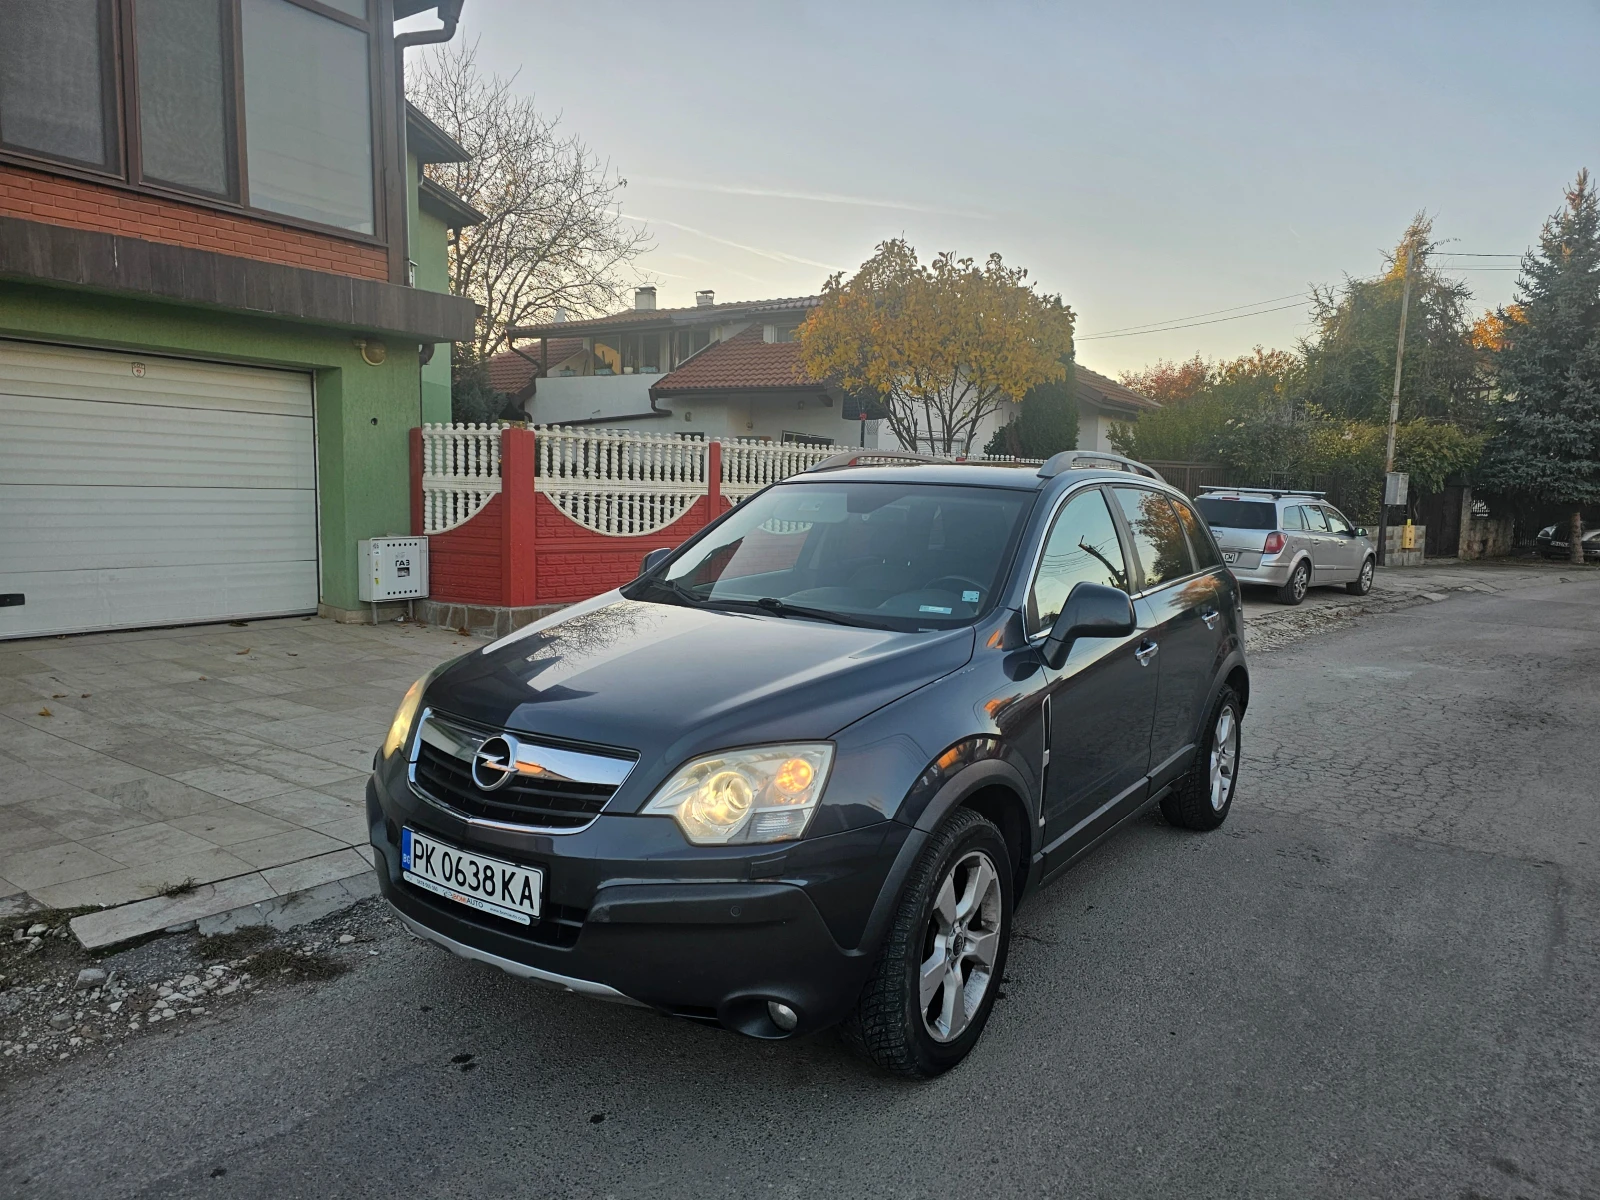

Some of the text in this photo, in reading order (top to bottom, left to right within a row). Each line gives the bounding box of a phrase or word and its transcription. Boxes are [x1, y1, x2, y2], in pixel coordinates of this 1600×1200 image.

[395, 559, 410, 567] ГАЗ
[403, 853, 410, 864] BG
[413, 839, 534, 910] PK 0638 KA
